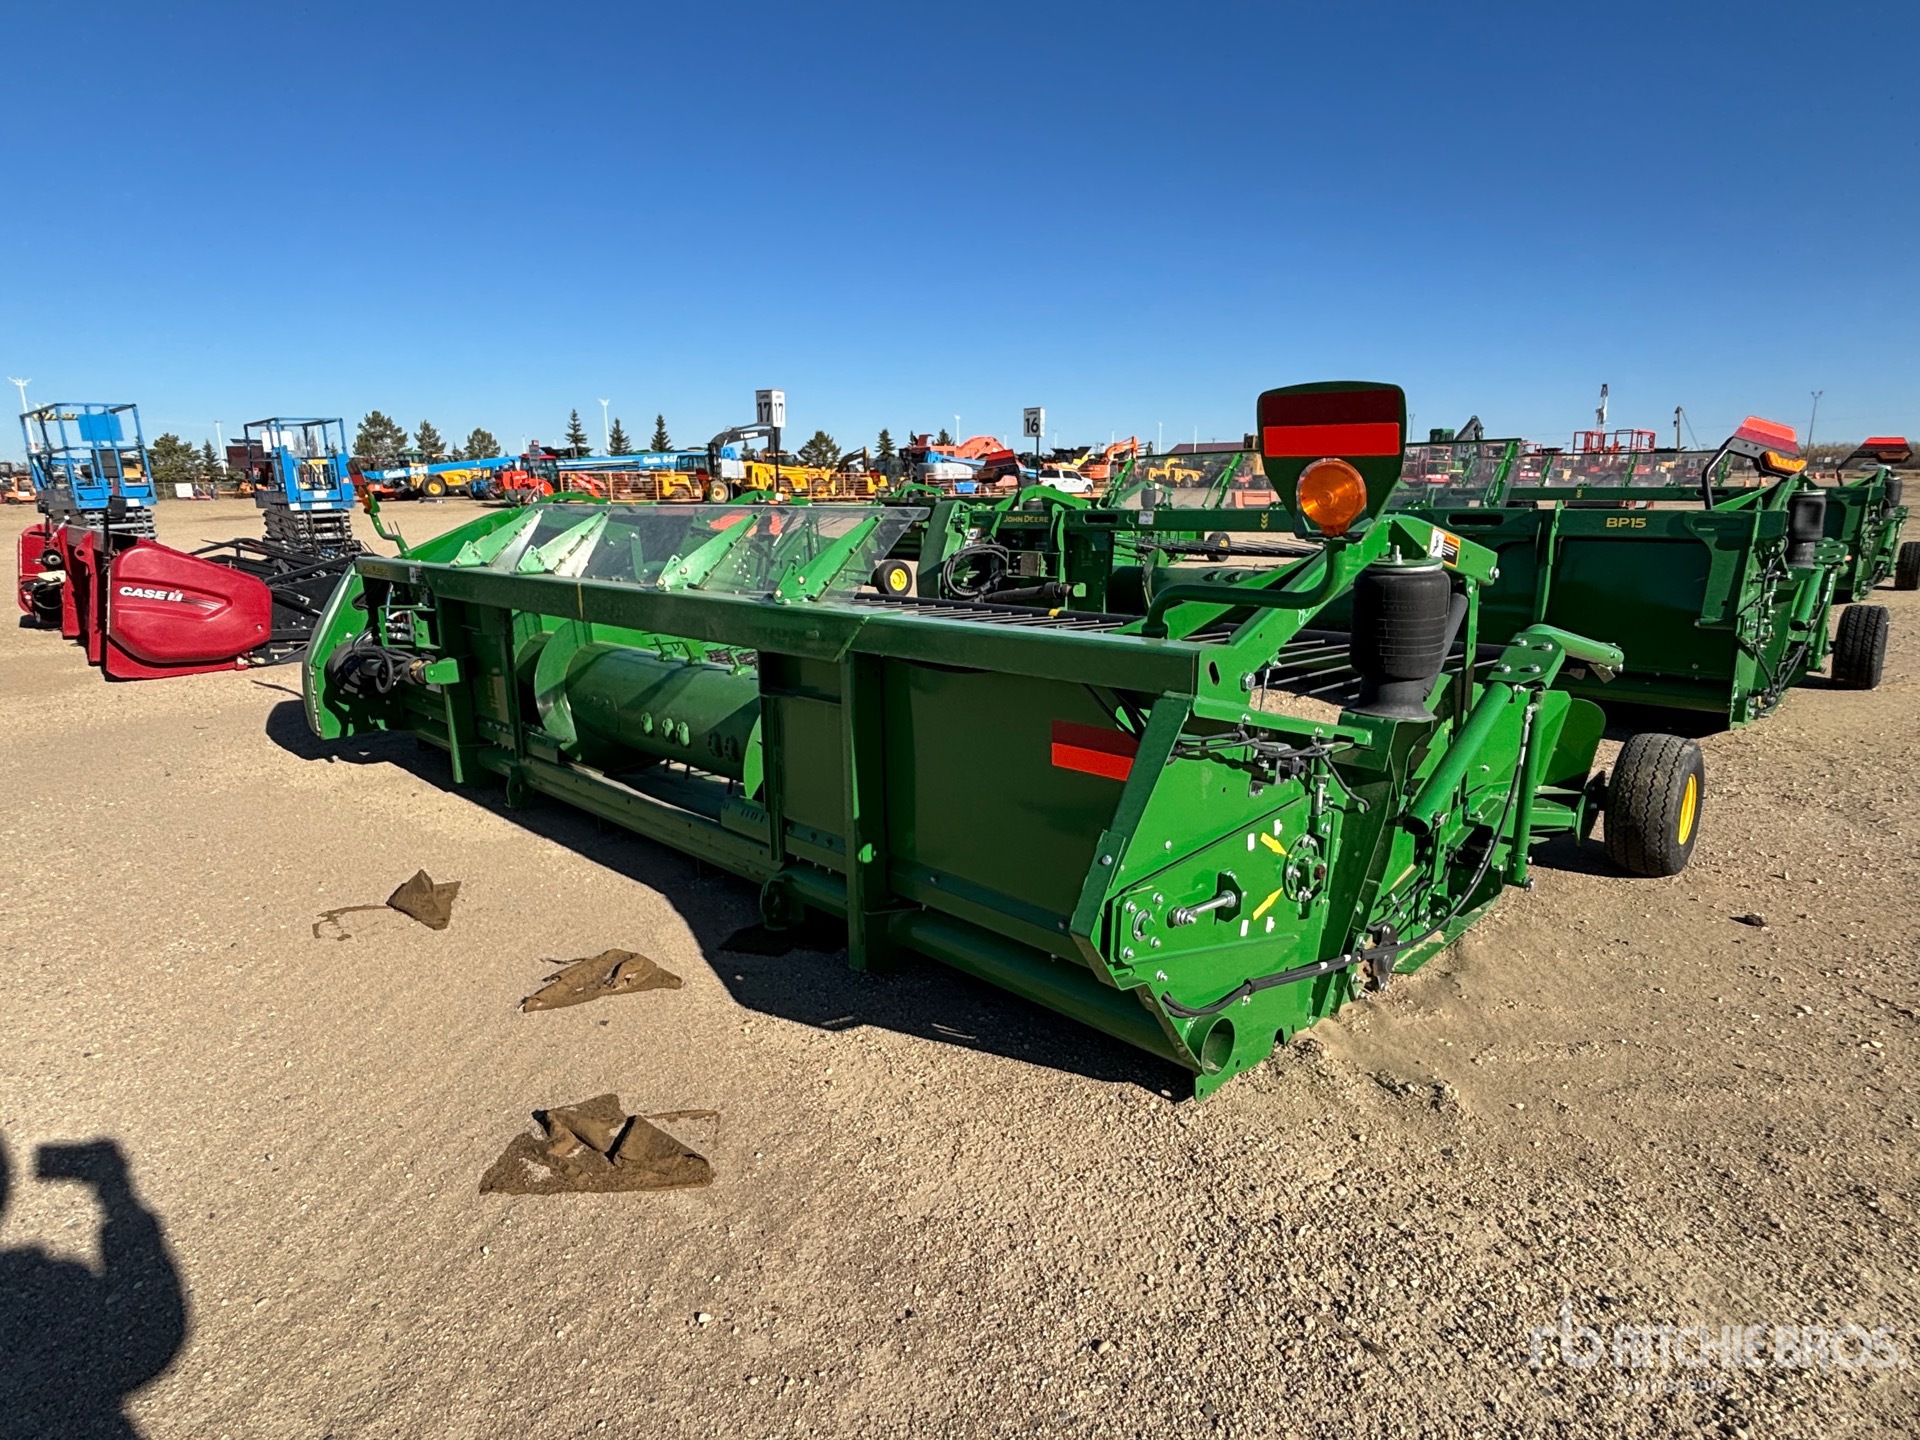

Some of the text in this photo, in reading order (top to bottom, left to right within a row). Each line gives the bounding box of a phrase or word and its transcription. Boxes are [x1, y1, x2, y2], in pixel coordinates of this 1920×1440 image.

[757, 401, 771, 423] 17
[774, 402, 784, 422] 17
[1025, 417, 1039, 434] 16
[1003, 514, 1049, 523] JOHN DEERE
[1606, 517, 1647, 528] BP15
[119, 586, 167, 600] CASE
